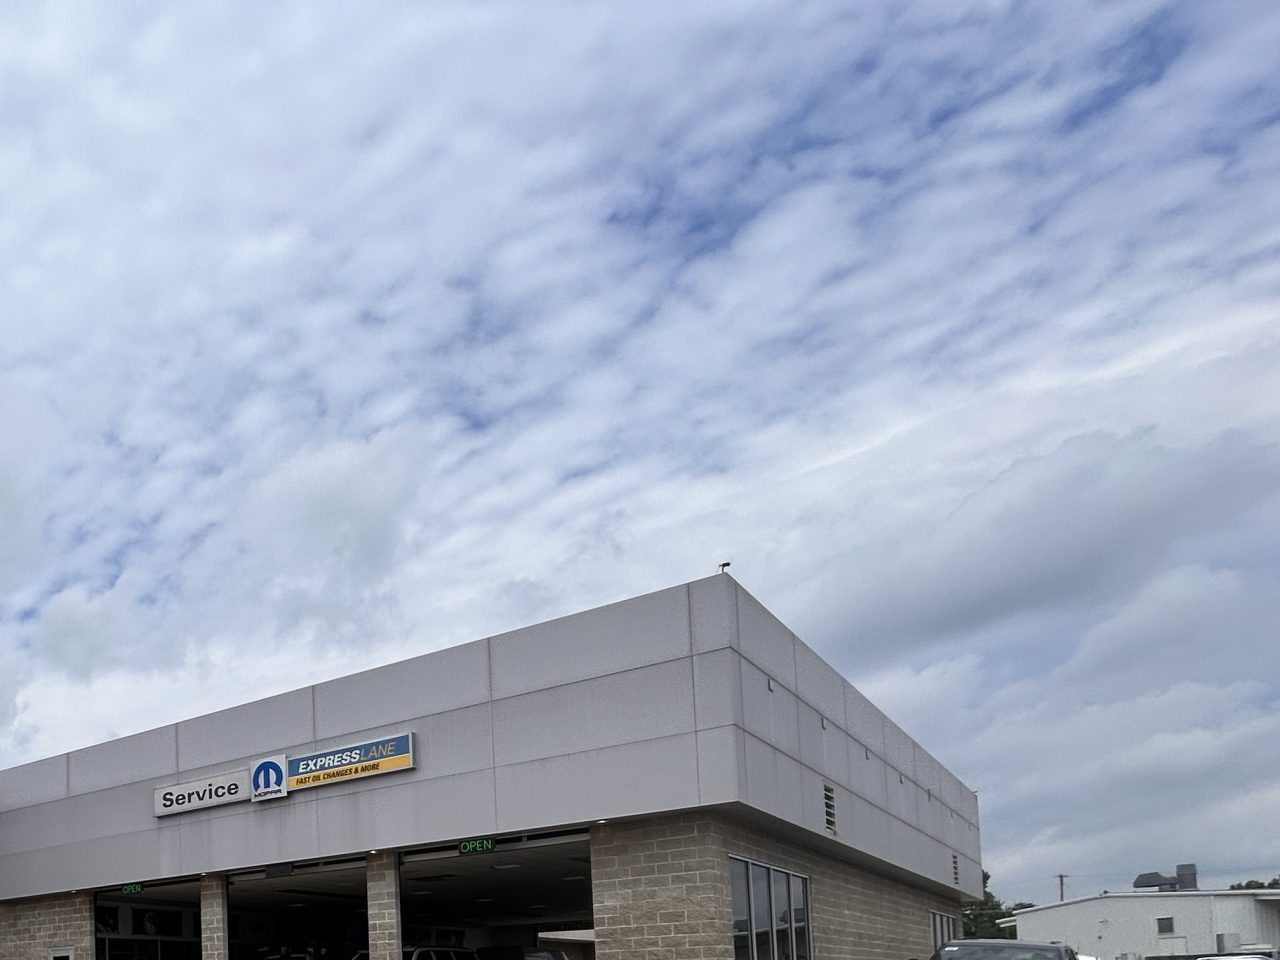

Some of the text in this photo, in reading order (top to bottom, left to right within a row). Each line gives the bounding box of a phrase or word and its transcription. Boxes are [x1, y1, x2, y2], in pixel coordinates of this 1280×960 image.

[295, 776, 311, 786] FAST
[312, 775, 321, 783] OIL
[323, 768, 352, 780] CHANGES
[361, 763, 380, 773] MORE
[162, 782, 239, 808] Service
[254, 788, 282, 798] MOPAR
[460, 839, 492, 852] OPEN
[122, 884, 141, 894] OPEN
